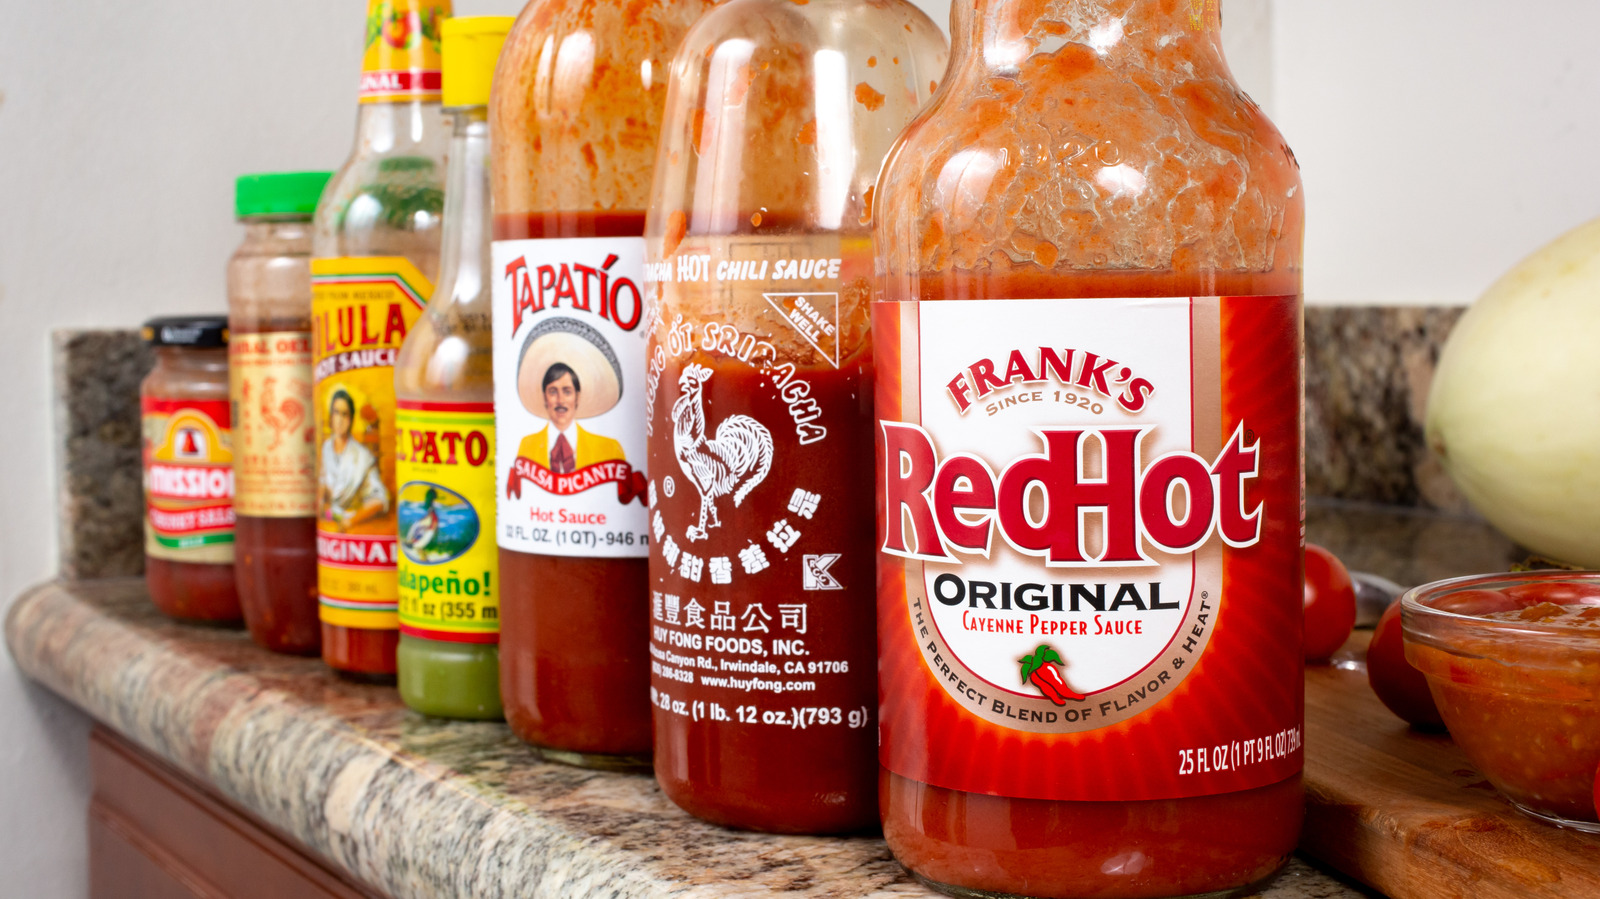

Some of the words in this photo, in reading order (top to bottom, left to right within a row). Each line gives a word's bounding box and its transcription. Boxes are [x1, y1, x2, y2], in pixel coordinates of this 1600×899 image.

[677, 254, 711, 282] HOT
[716, 260, 768, 280] CHILI
[772, 259, 842, 280] SAUCE
[505, 253, 642, 340] TAPATÍO
[789, 308, 822, 343] WELL
[794, 296, 836, 337] SHAKE
[946, 346, 1155, 413] FRANK'S
[986, 391, 1043, 416] SINCE
[1054, 390, 1104, 415] 1920
[410, 430, 488, 466] PATO
[515, 459, 553, 490] SALSA
[558, 463, 628, 493] PICANTE
[880, 419, 1264, 566] RedHot
[530, 507, 554, 523] Hot
[559, 508, 607, 525] Sauce
[933, 573, 1180, 611] ORIGINAL
[962, 610, 1024, 634] CAYENNE
[1030, 613, 1087, 635] PEPPER
[1094, 614, 1142, 635] SAUCE
[653, 624, 668, 643] HUY
[669, 630, 702, 650] FONG
[705, 636, 768, 657] FOODS,
[773, 639, 810, 656] INC.
[664, 651, 695, 667] Canyon
[697, 656, 718, 672] Rd.,
[720, 659, 781, 675] Irwindale,
[784, 661, 805, 674] CA
[808, 661, 849, 674] 91706
[913, 597, 929, 638] THE
[926, 641, 987, 706] PERFECT
[991, 699, 1058, 723] BLEND
[1064, 708, 1093, 723] OF
[1099, 670, 1172, 717] FLAVOR
[1171, 656, 1185, 670] &
[701, 675, 816, 693] www.huyfong.com
[659, 692, 671, 711] 28
[672, 700, 689, 716] oz.
[692, 700, 705, 722] (1
[710, 703, 731, 722] lb.
[736, 705, 757, 723] 12
[848, 706, 868, 728] g)
[1179, 749, 1194, 775] 25
[1197, 747, 1210, 773] FL
[1213, 745, 1229, 771] OZ
[1231, 740, 1240, 771] (1
[1243, 739, 1256, 765] PT
[1257, 737, 1263, 763] 9
[1265, 735, 1274, 760] FL
[1275, 728, 1287, 759] OZ)
